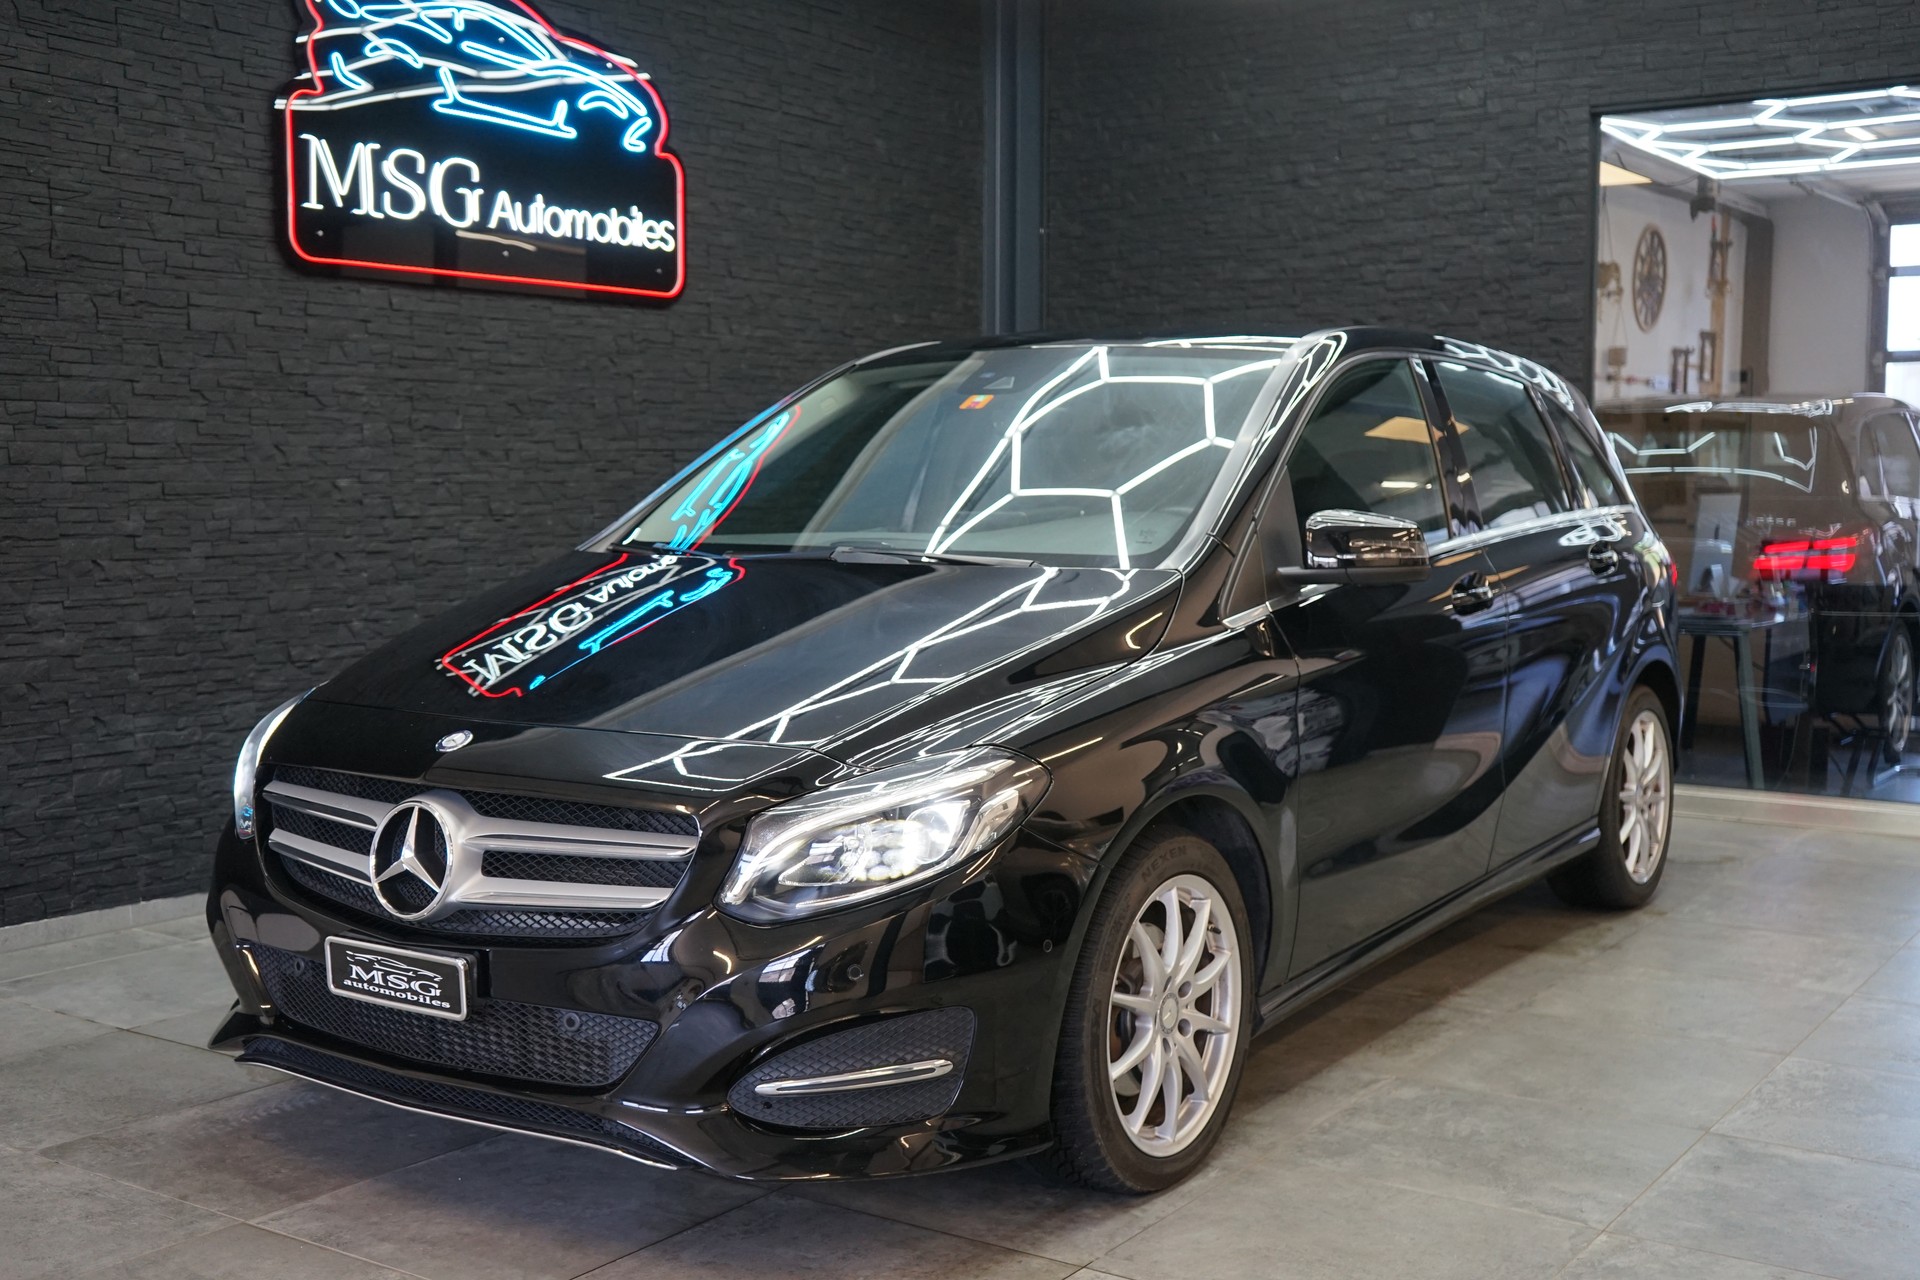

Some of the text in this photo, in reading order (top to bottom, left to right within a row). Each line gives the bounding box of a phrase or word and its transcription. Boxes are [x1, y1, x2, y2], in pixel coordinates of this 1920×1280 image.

[299, 133, 677, 253] MSG Automobiles
[1141, 844, 1188, 882] NEXEN
[343, 978, 451, 1009] automobiles
[348, 963, 442, 997] MSG
